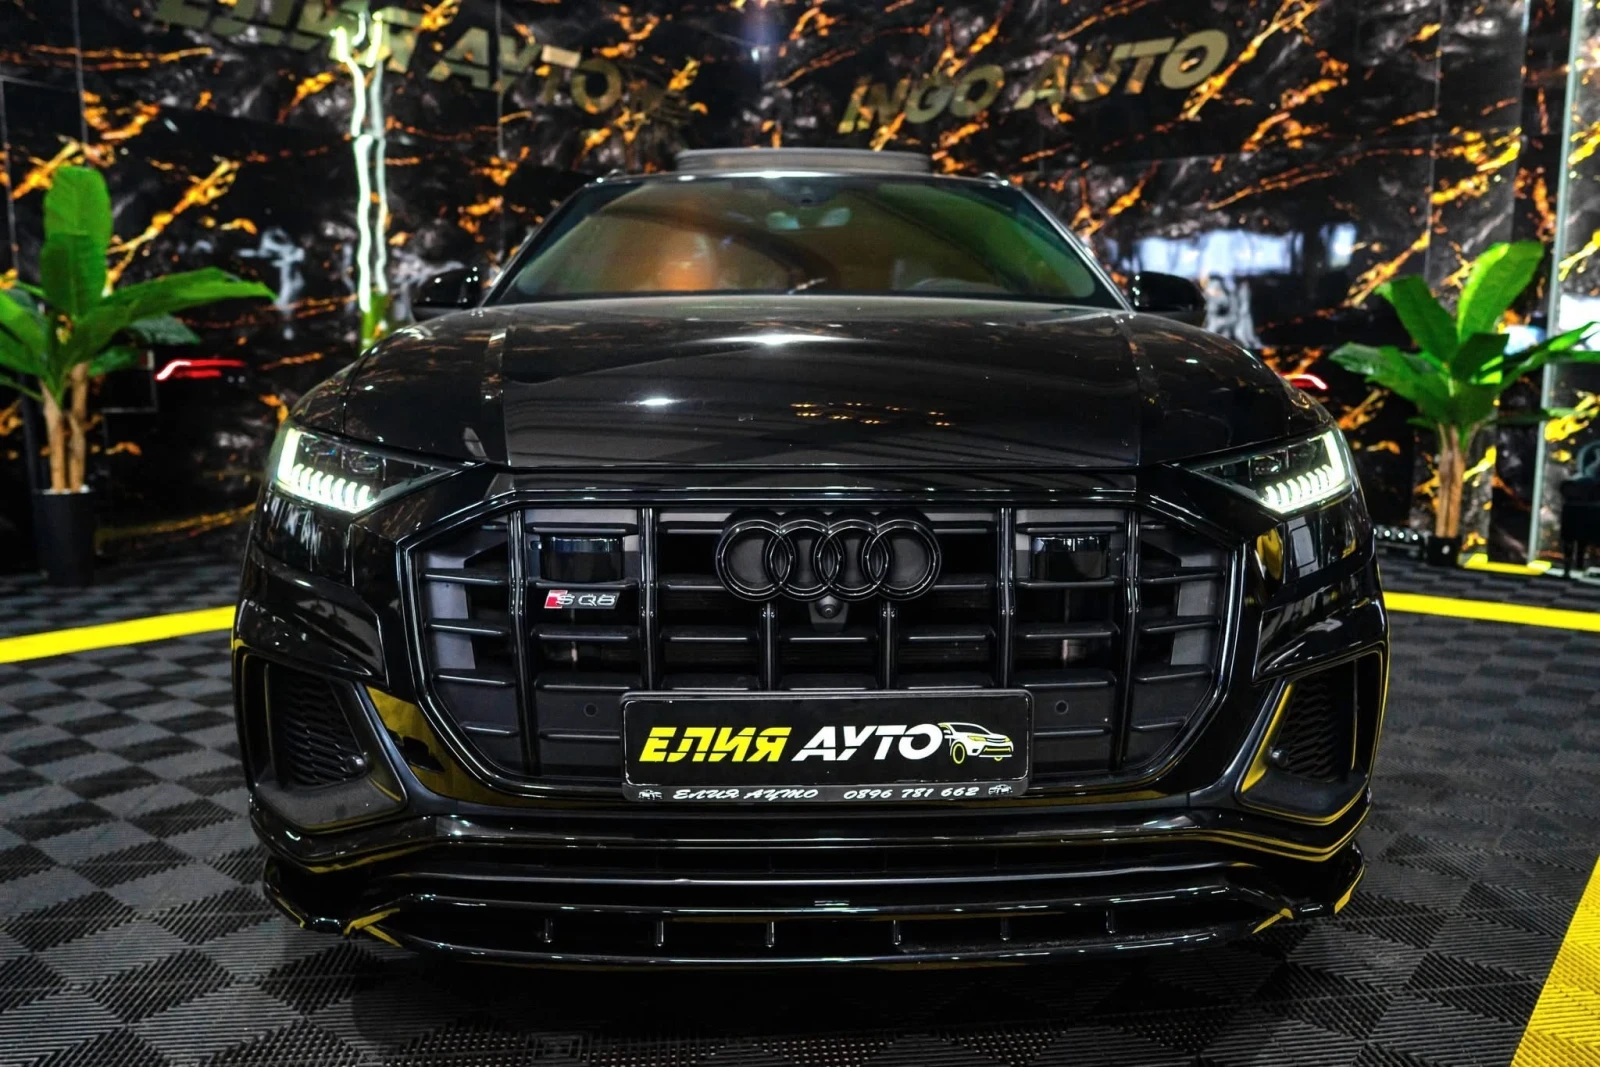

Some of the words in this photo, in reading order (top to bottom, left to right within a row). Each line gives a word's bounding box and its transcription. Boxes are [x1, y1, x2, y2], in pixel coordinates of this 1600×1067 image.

[837, 63, 1005, 135] INGO
[1013, 28, 1229, 111] AUTO
[638, 726, 792, 763] ЕЛИЯ
[791, 723, 944, 762] АУТО
[843, 788, 893, 800] 0896
[901, 787, 935, 799] 781
[940, 786, 980, 798] 662
